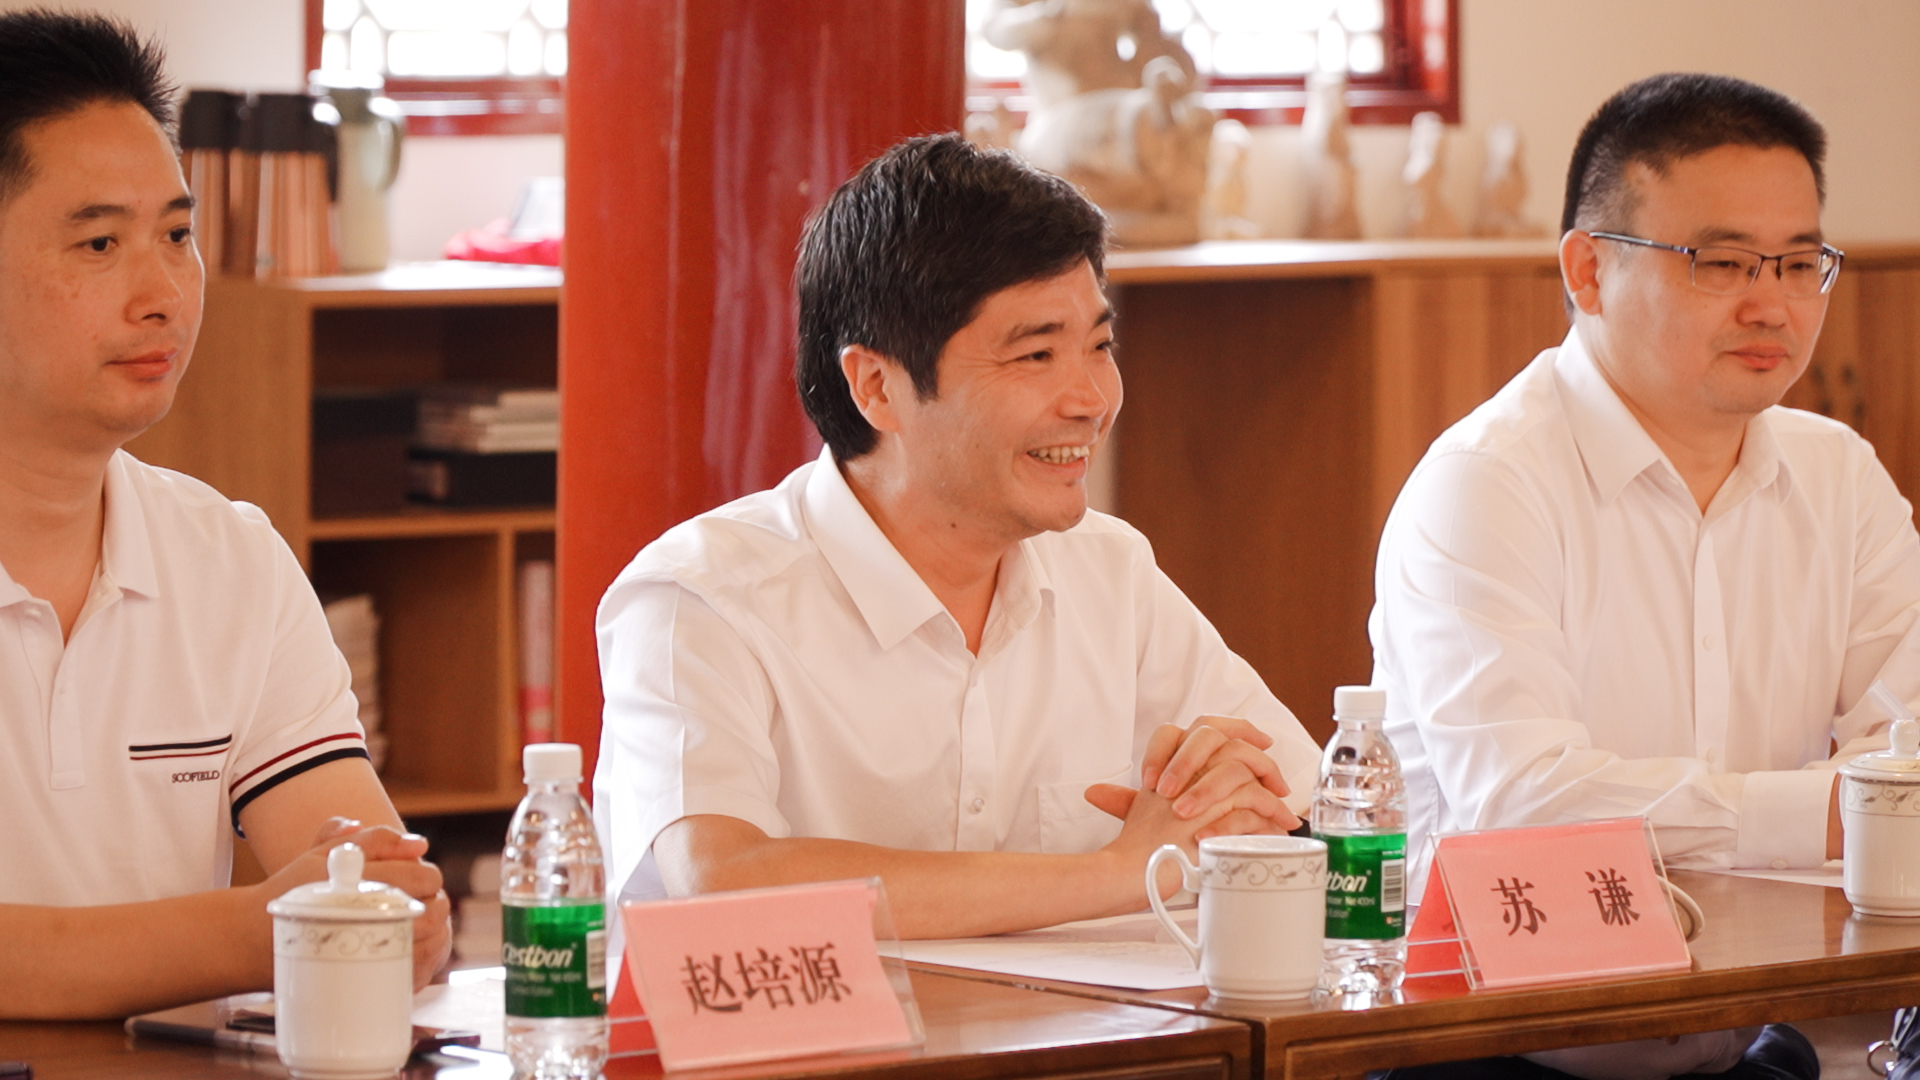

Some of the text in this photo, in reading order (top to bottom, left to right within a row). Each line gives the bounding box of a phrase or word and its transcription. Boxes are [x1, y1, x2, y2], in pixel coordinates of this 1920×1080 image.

[171, 770, 220, 783] SCOFIELD
[1326, 871, 1368, 892] tbon
[679, 942, 852, 1016] 赵培源
